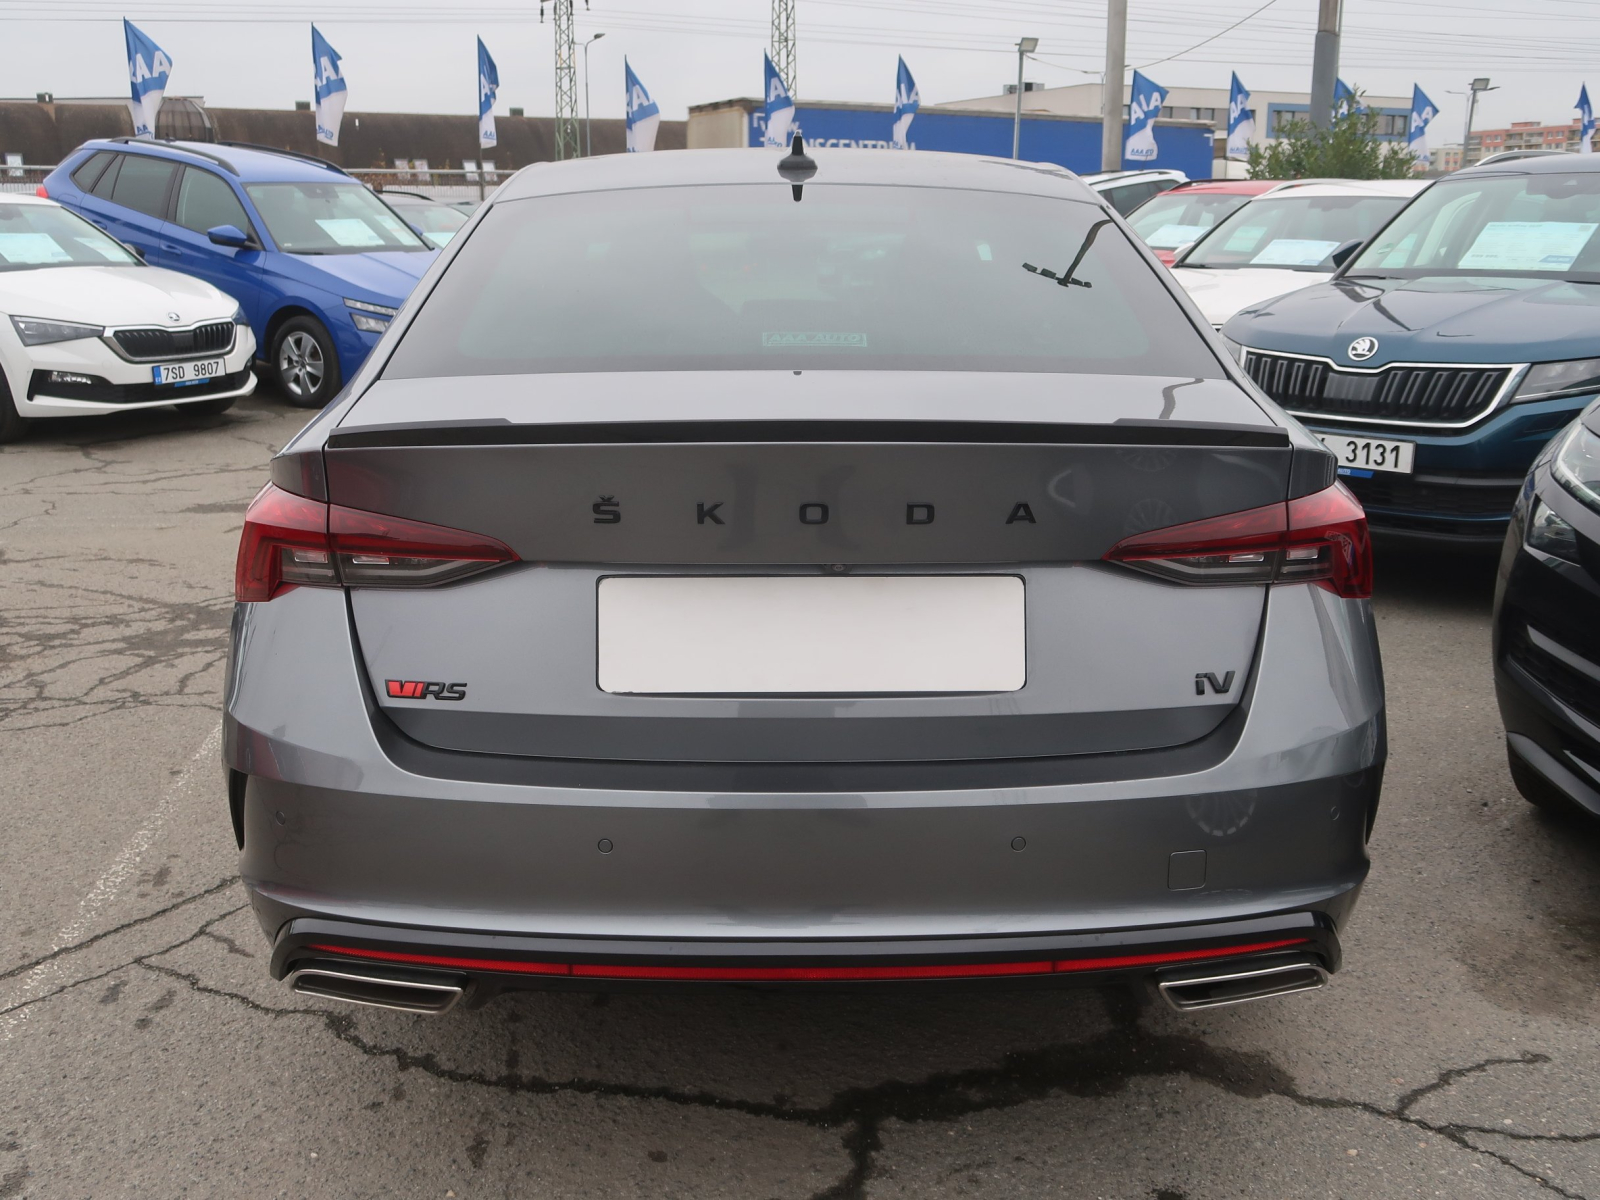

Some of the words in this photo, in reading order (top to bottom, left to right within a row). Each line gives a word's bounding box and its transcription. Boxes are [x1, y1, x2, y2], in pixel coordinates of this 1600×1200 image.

[163, 365, 185, 381] 7SD
[193, 361, 219, 377] 9807
[1345, 440, 1401, 468] 3131
[592, 495, 1037, 525] ŠKODA
